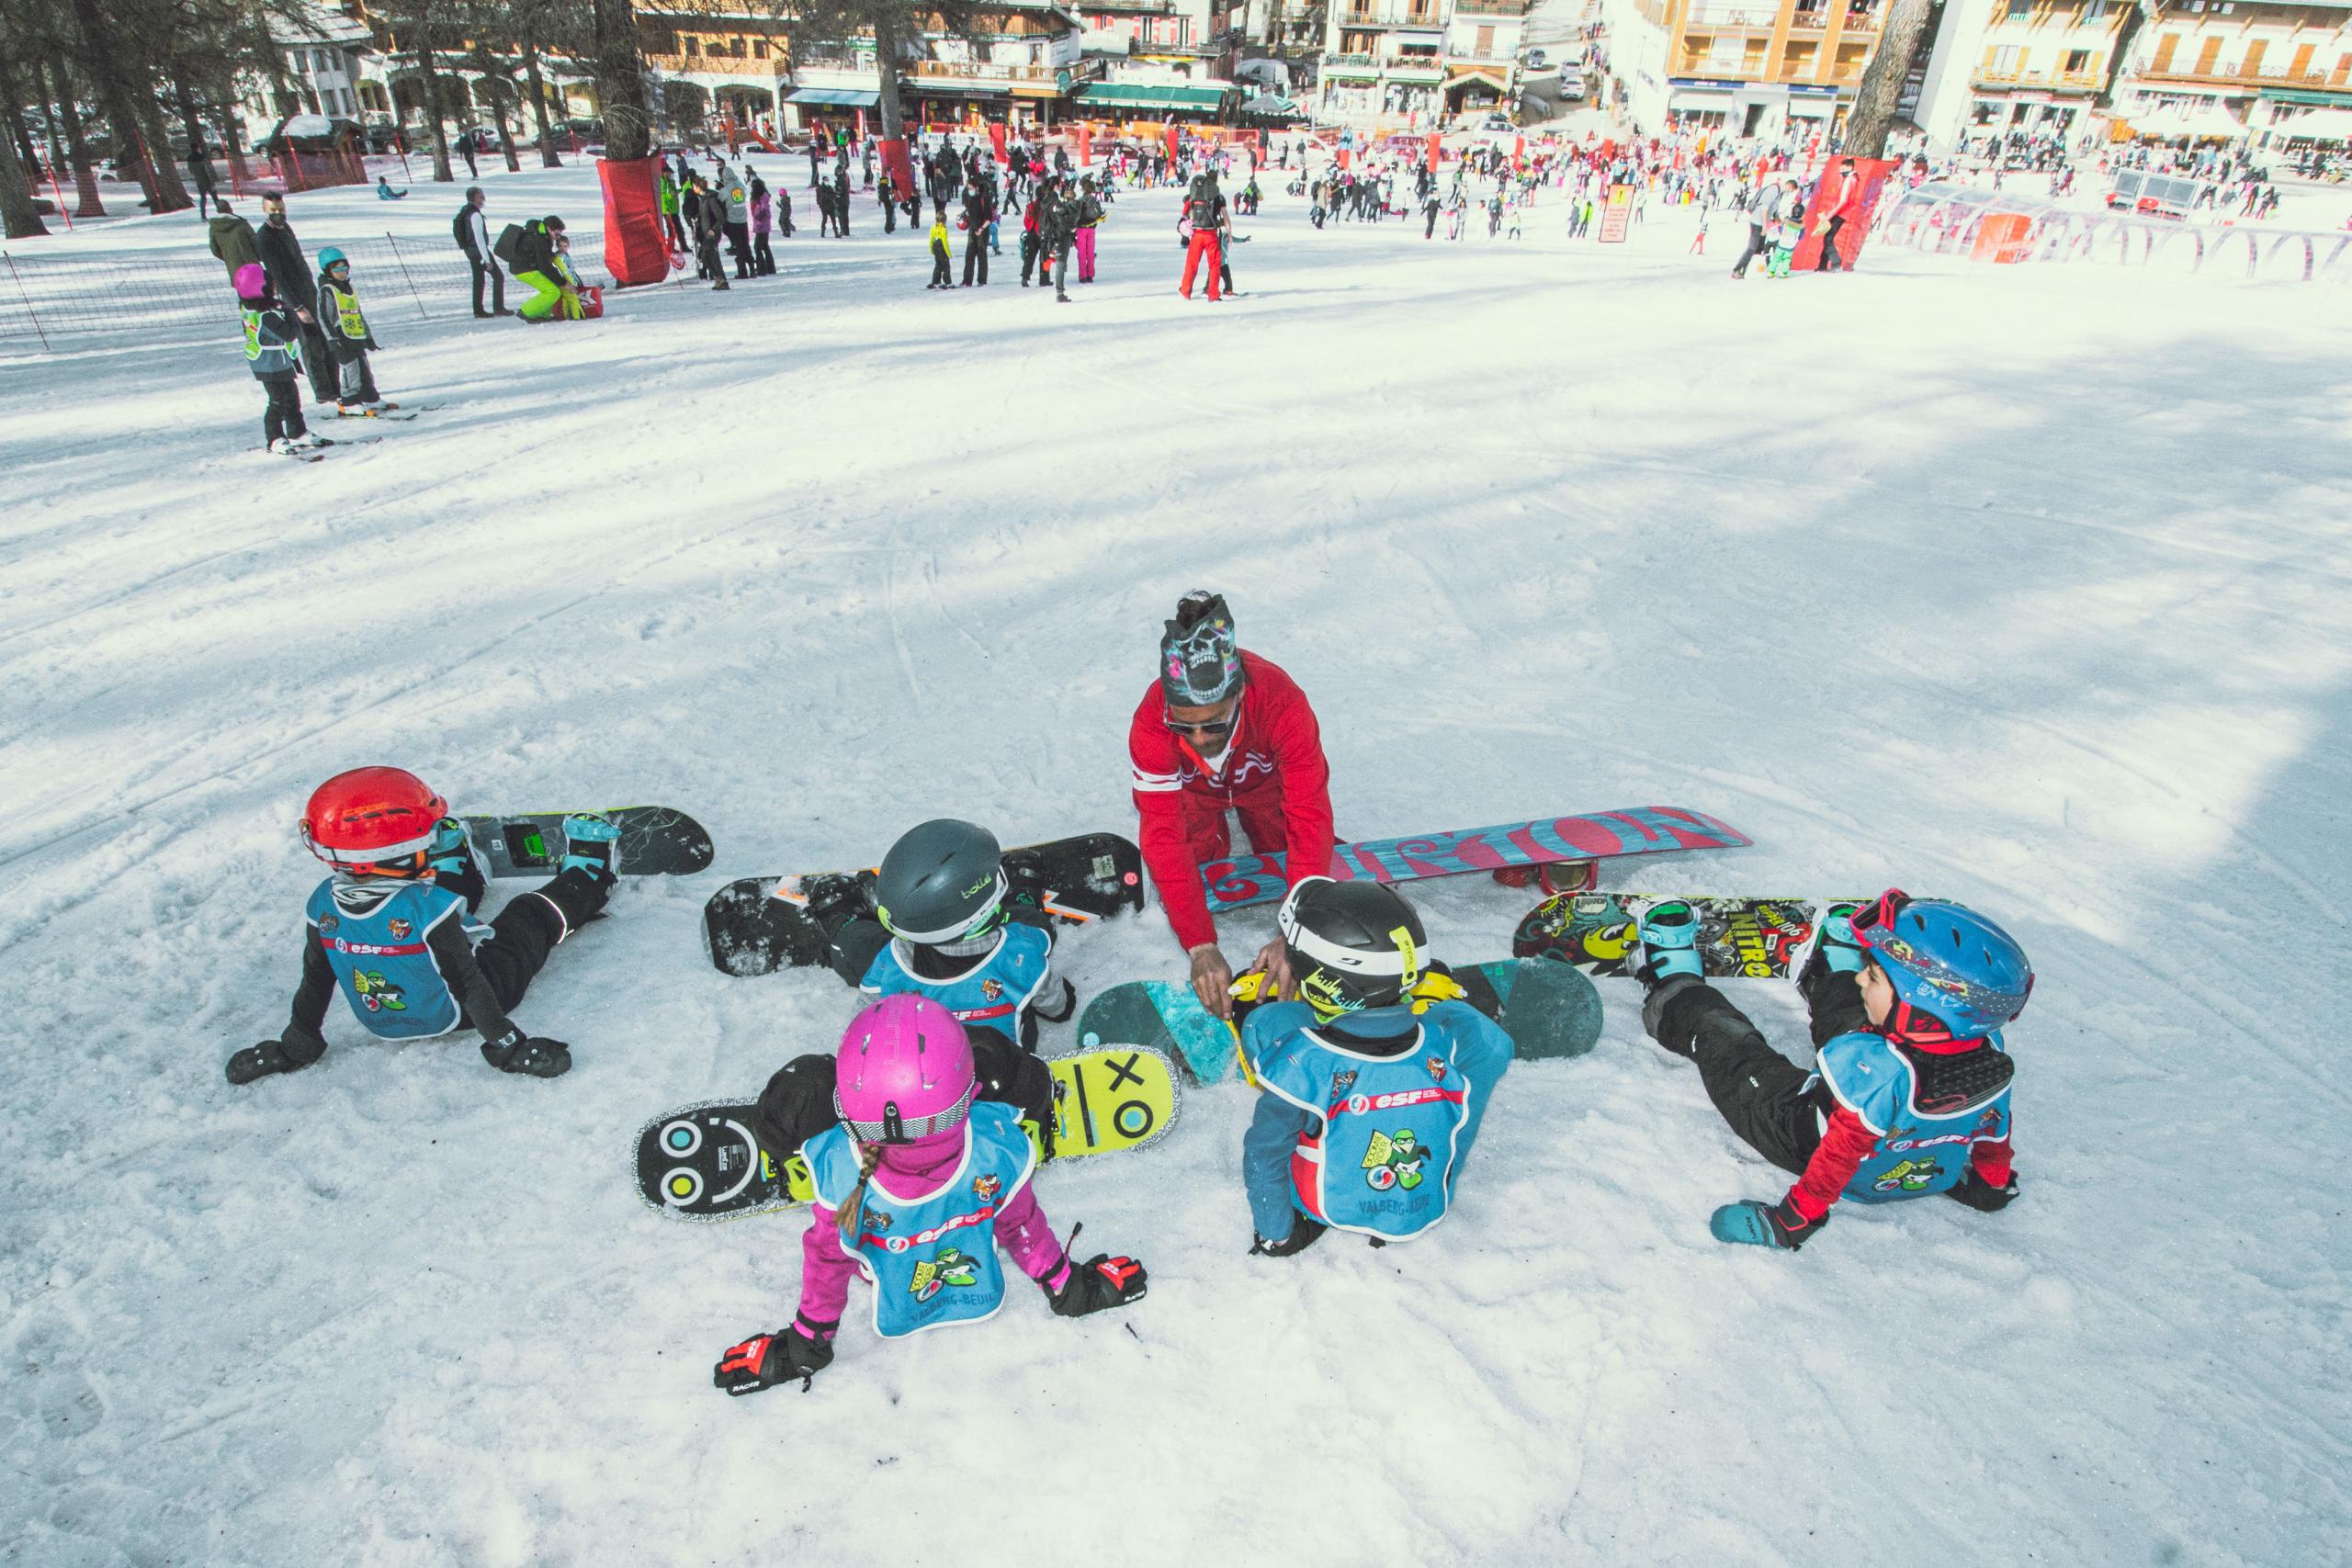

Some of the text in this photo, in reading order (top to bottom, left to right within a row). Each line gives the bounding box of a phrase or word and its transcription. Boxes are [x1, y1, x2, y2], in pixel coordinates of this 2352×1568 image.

[1776, 920, 1805, 937] 106
[1728, 913, 1772, 977] NITRO
[732, 1381, 761, 1393] RACER
